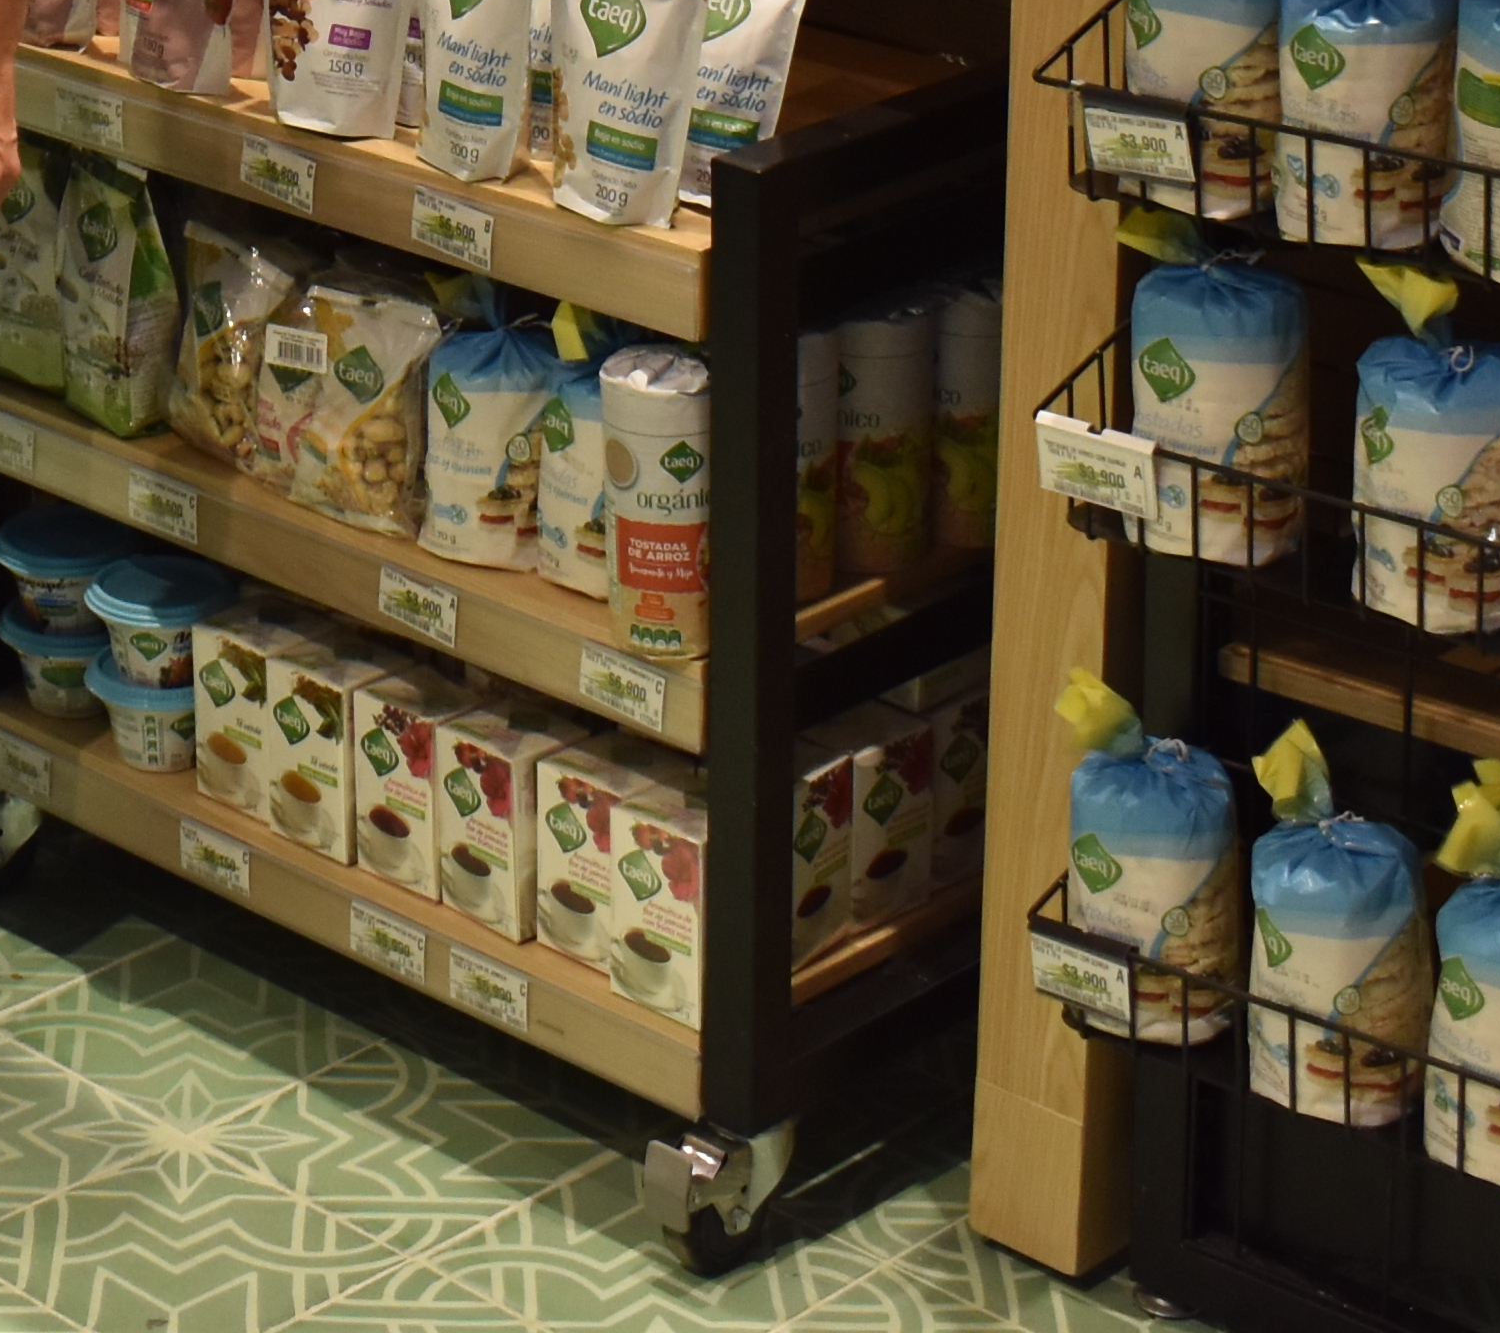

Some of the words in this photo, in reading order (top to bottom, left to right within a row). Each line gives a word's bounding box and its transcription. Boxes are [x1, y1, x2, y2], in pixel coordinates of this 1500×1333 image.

[437, 31, 471, 59] Maní
[470, 45, 512, 75] light
[448, 59, 465, 76] en
[467, 61, 508, 88] sodio
[583, 70, 623, 97] Maní
[623, 82, 670, 111] light
[597, 98, 617, 116] en
[619, 102, 664, 130] sodio
[636, 488, 710, 518] orgáni
[627, 546, 645, 560] DE
[646, 548, 692, 563] ARROZ
[629, 538, 689, 554] TOSTADAS
